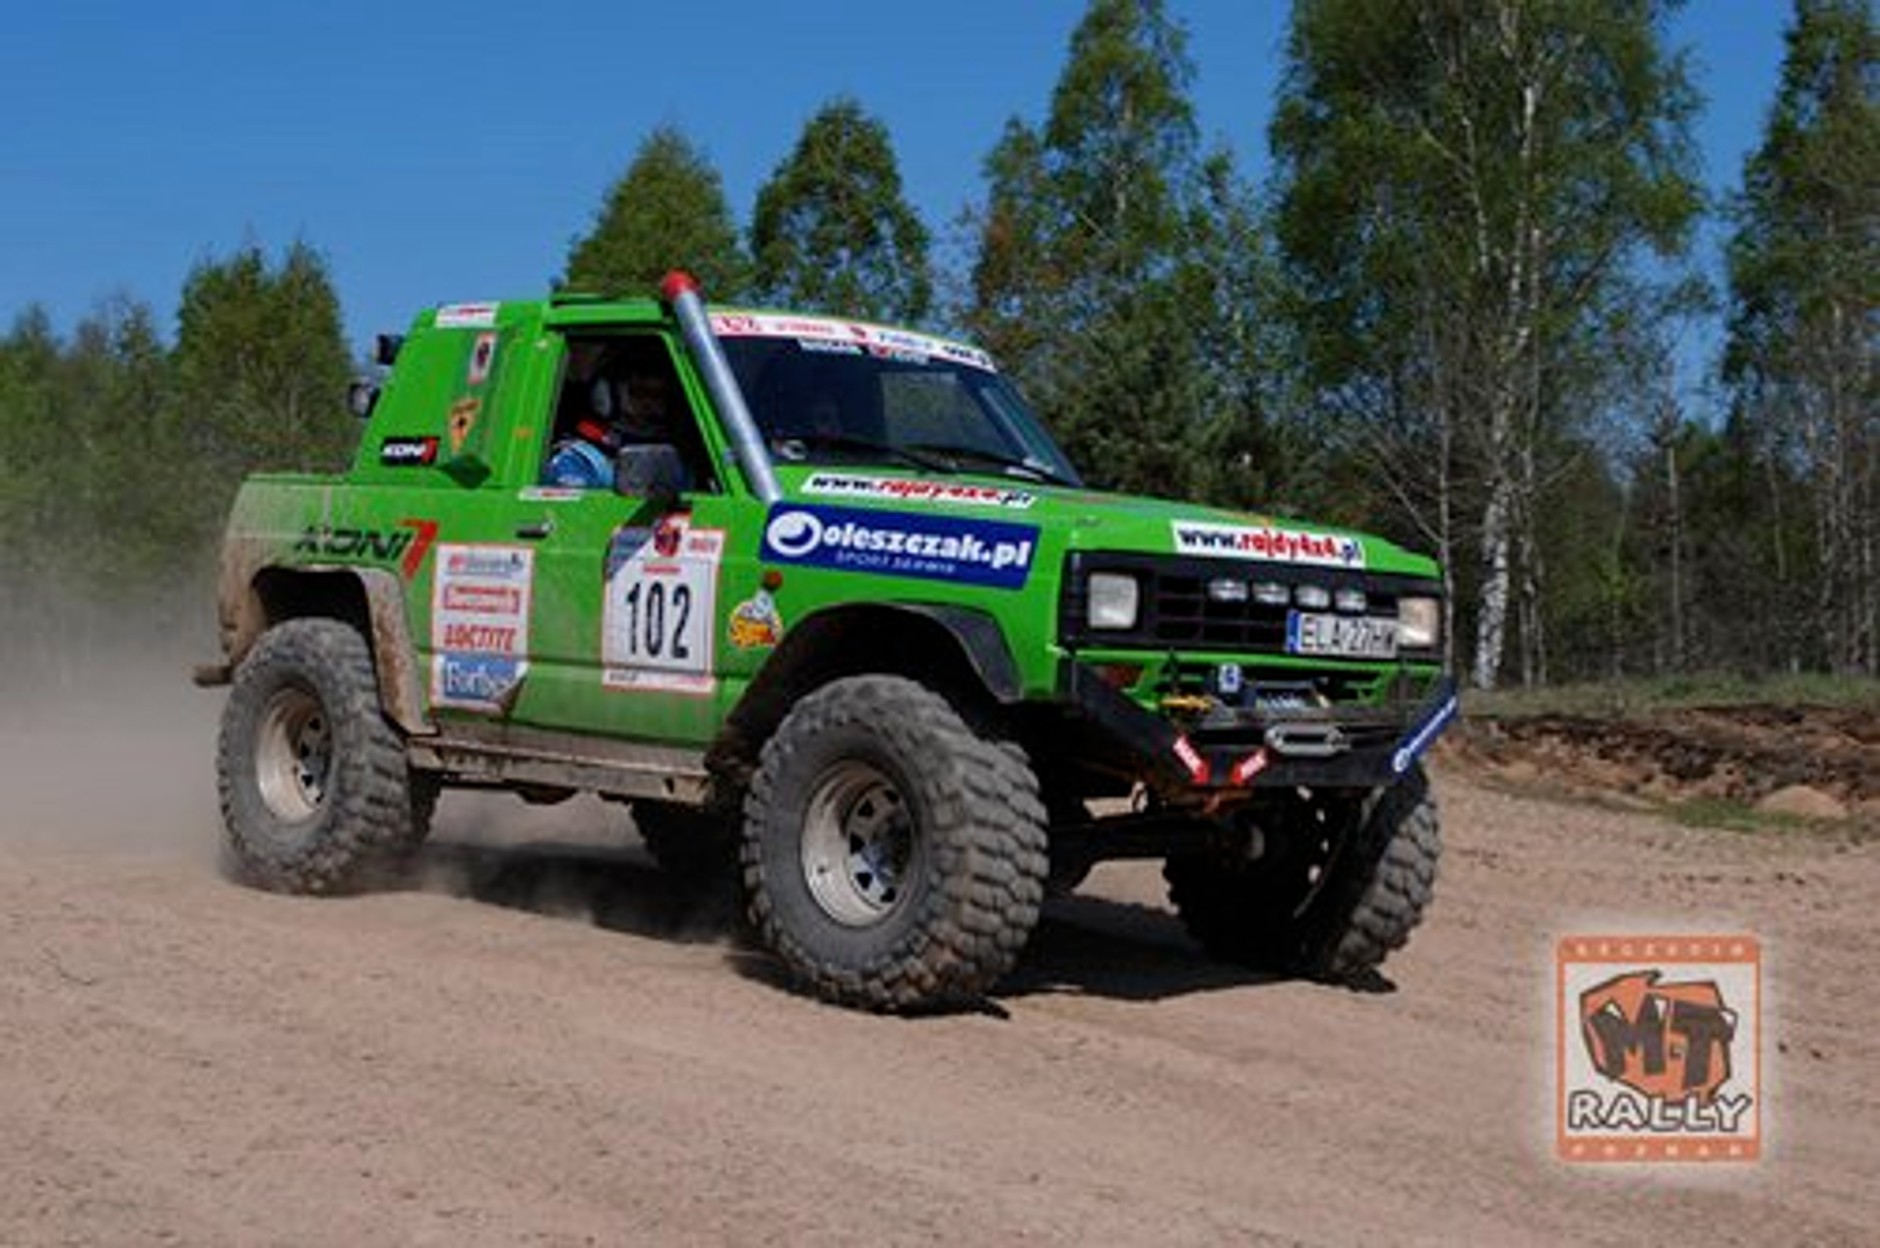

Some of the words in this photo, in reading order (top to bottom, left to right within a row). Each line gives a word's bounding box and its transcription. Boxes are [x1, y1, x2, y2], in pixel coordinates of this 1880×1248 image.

[821, 521, 1032, 571] oleszczak.pl
[1178, 526, 1362, 566] www.rajdy4x4.pl
[626, 580, 691, 659] 102
